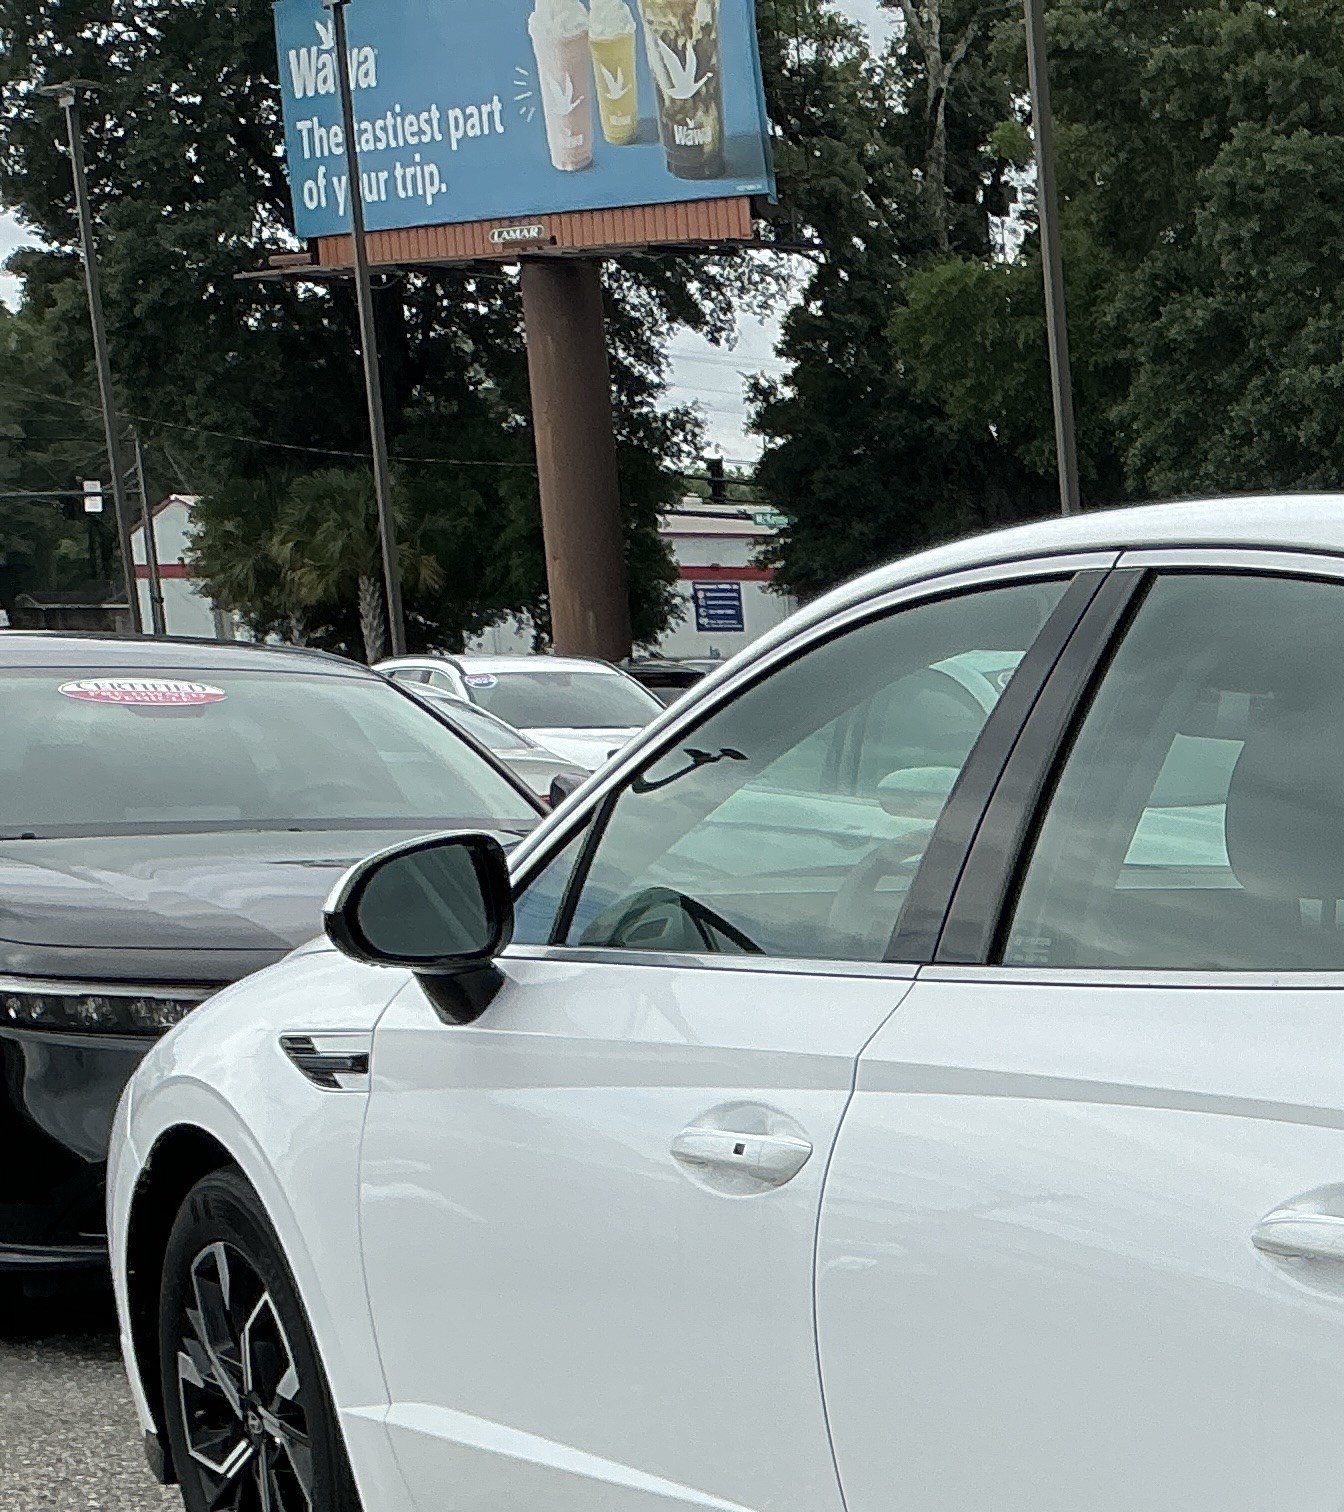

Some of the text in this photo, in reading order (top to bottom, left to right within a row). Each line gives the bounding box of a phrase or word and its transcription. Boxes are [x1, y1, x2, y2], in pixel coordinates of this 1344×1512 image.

[296, 116, 344, 159] The
[448, 96, 505, 151] part
[303, 153, 447, 217] of yur trip.
[492, 226, 539, 242] LAMAR
